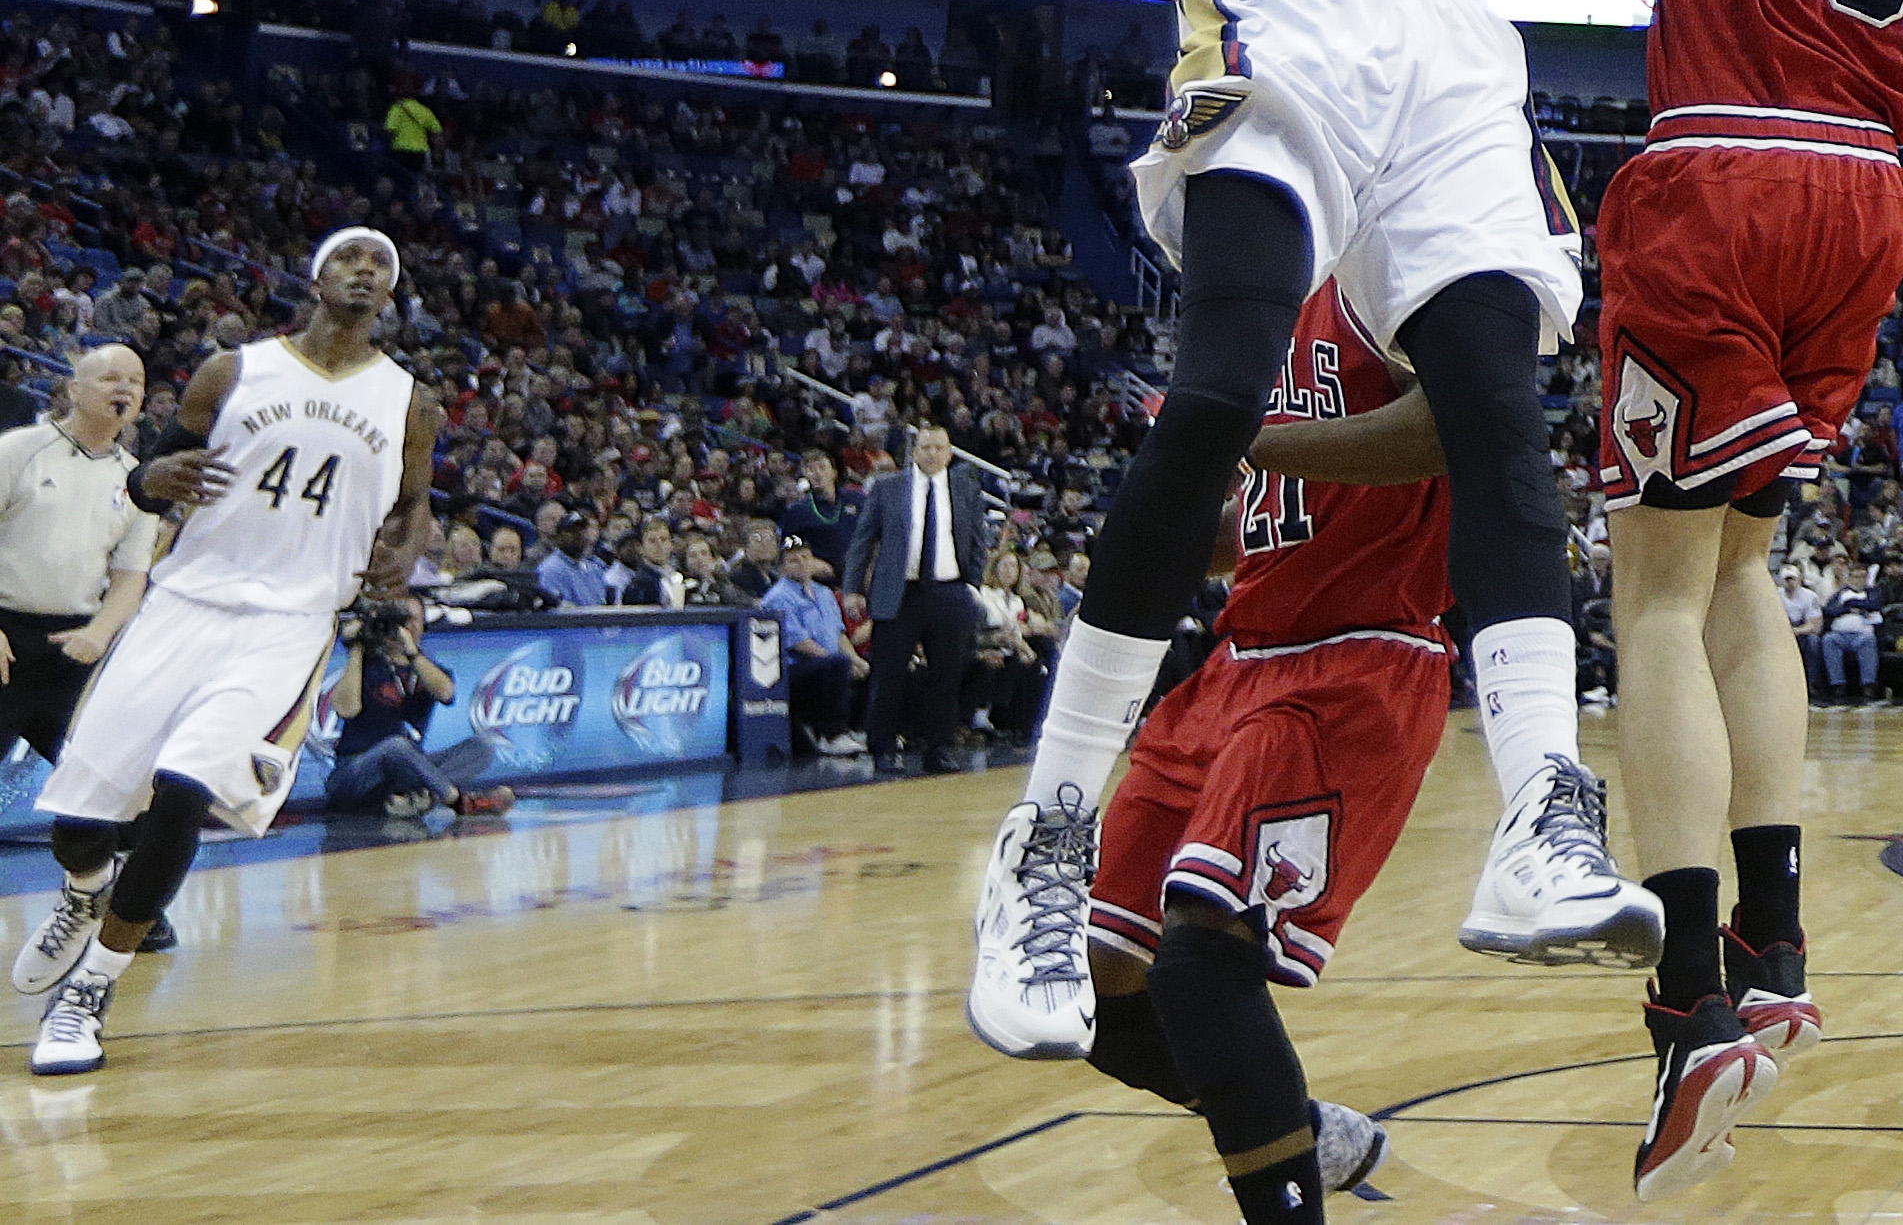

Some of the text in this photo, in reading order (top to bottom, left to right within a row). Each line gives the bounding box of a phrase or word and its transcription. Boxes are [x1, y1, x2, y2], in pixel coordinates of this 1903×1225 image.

[1264, 336, 1346, 421] LS
[241, 399, 389, 455] NEW ORLEANS
[257, 445, 341, 517] 44
[1240, 469, 1314, 557] 21
[503, 665, 574, 696] BUD
[641, 657, 703, 688] BUD
[487, 694, 581, 725] LIGHT
[628, 686, 708, 717] LIGHT
